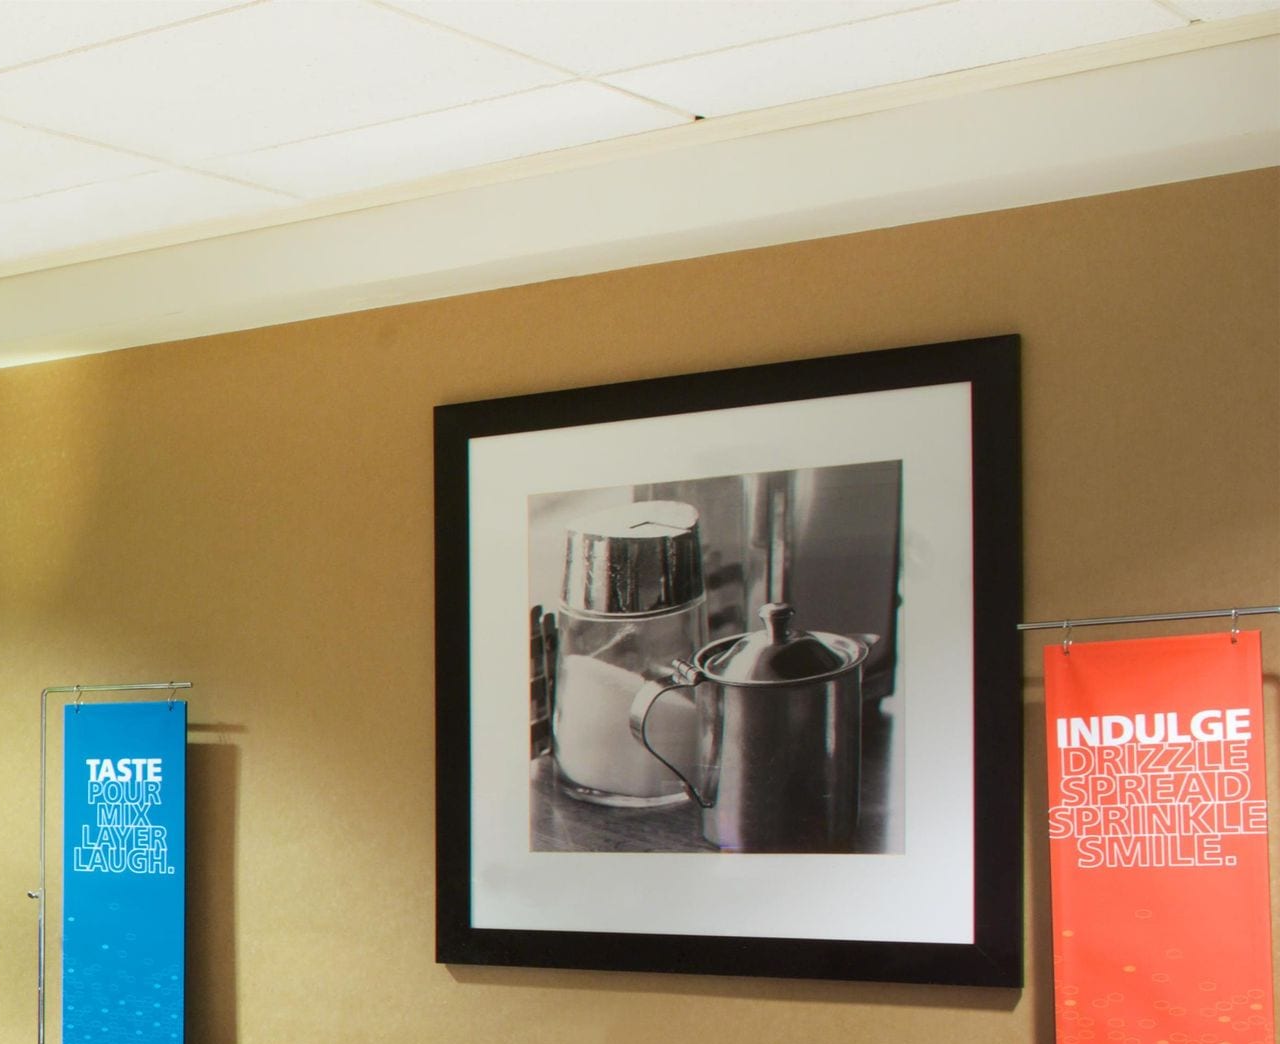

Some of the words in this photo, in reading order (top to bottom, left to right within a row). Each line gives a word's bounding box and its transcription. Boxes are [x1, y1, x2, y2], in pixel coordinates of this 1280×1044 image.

[1056, 708, 1252, 748] INDULGE
[86, 758, 163, 782] TASTE
[1060, 739, 1249, 778] DRIZZLE
[87, 779, 162, 805] POUR
[1059, 770, 1252, 809] SPREAD
[97, 802, 151, 828] MIX
[1048, 799, 1269, 839] SPRINKLE
[82, 824, 168, 851] LAYER
[1077, 832, 1238, 868] SMILE.
[73, 846, 175, 875] LAUGH.
